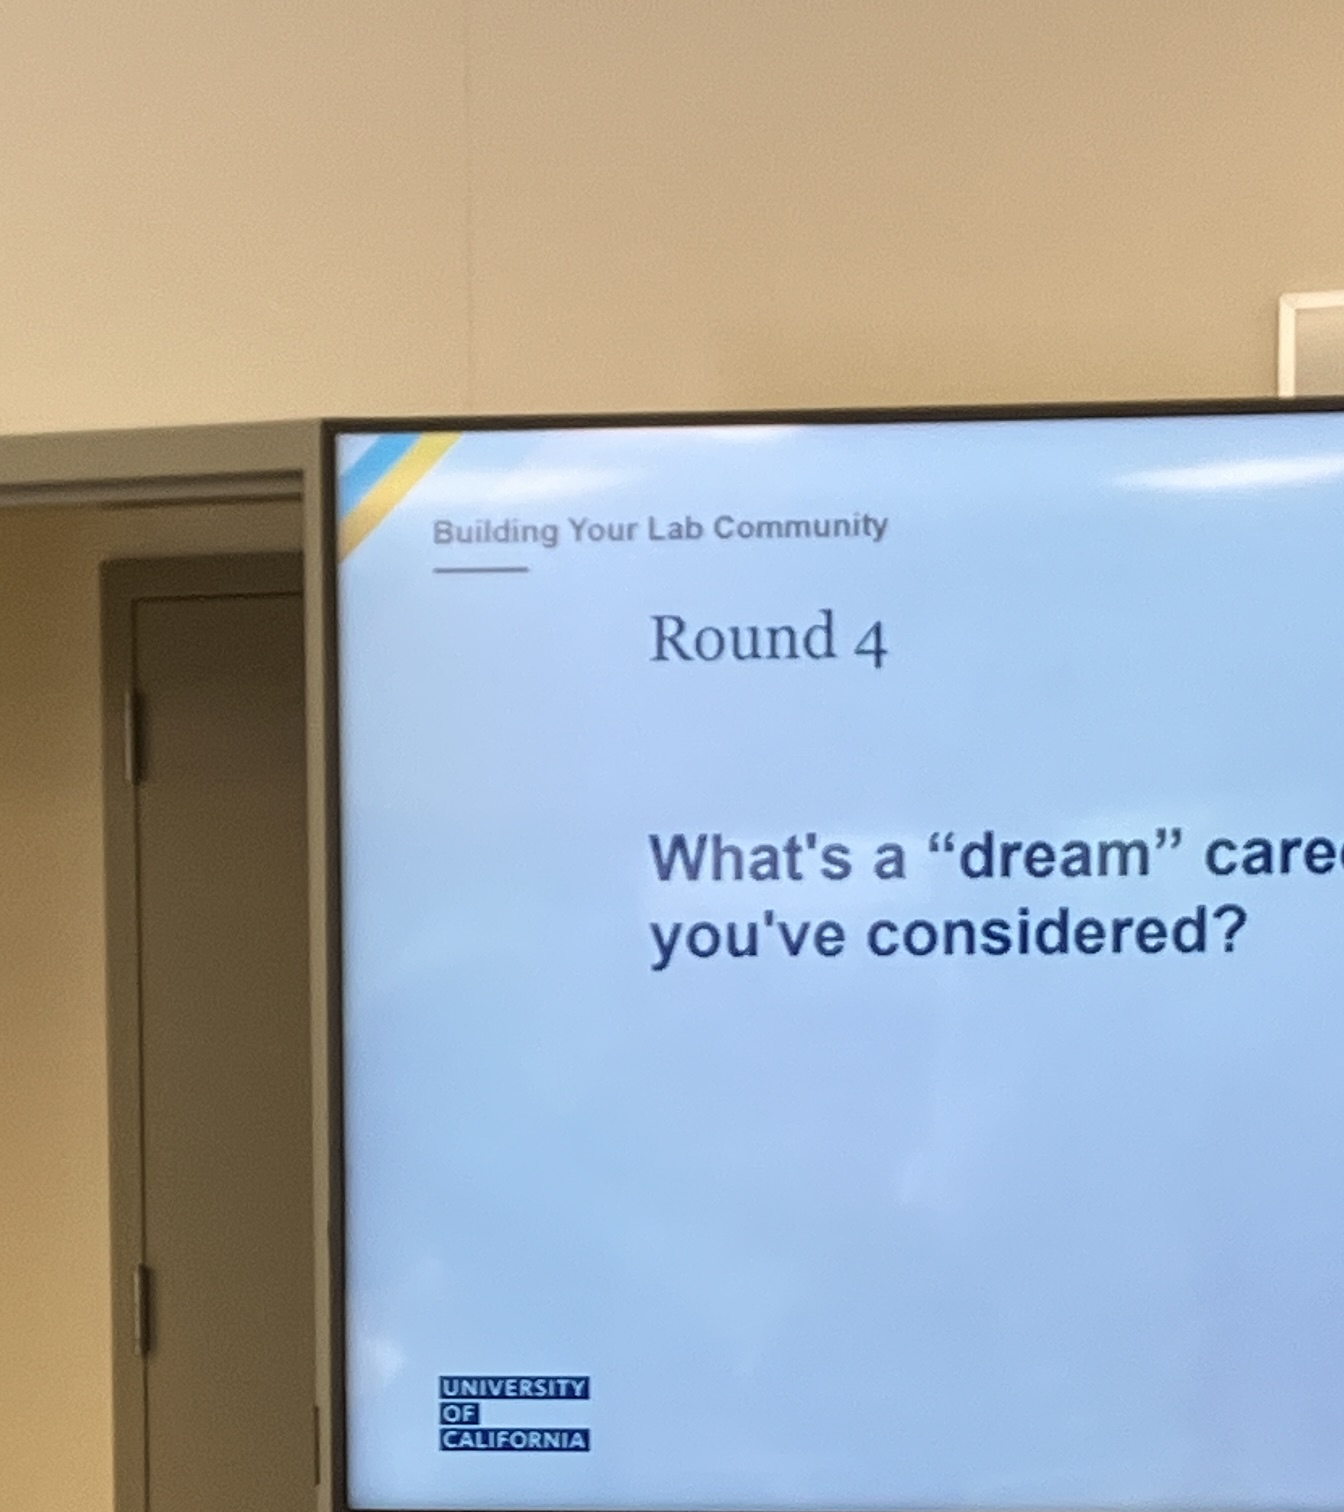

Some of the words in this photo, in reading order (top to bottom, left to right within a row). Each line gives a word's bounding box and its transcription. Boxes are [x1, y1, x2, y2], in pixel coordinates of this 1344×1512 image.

[433, 517, 559, 549] Building
[567, 516, 639, 543] Your
[647, 514, 705, 542] Lab
[713, 511, 890, 545] Community
[649, 607, 838, 663] Round
[853, 620, 889, 670] 4
[647, 830, 853, 883] What's
[873, 842, 908, 881] a
[928, 826, 1183, 880] “dream”
[648, 908, 847, 973] you've
[866, 902, 1248, 958] considered?
[441, 1378, 587, 1398] UNIVERSITY
[441, 1403, 476, 1423] OF
[441, 1429, 587, 1449] CALIFORNIA
